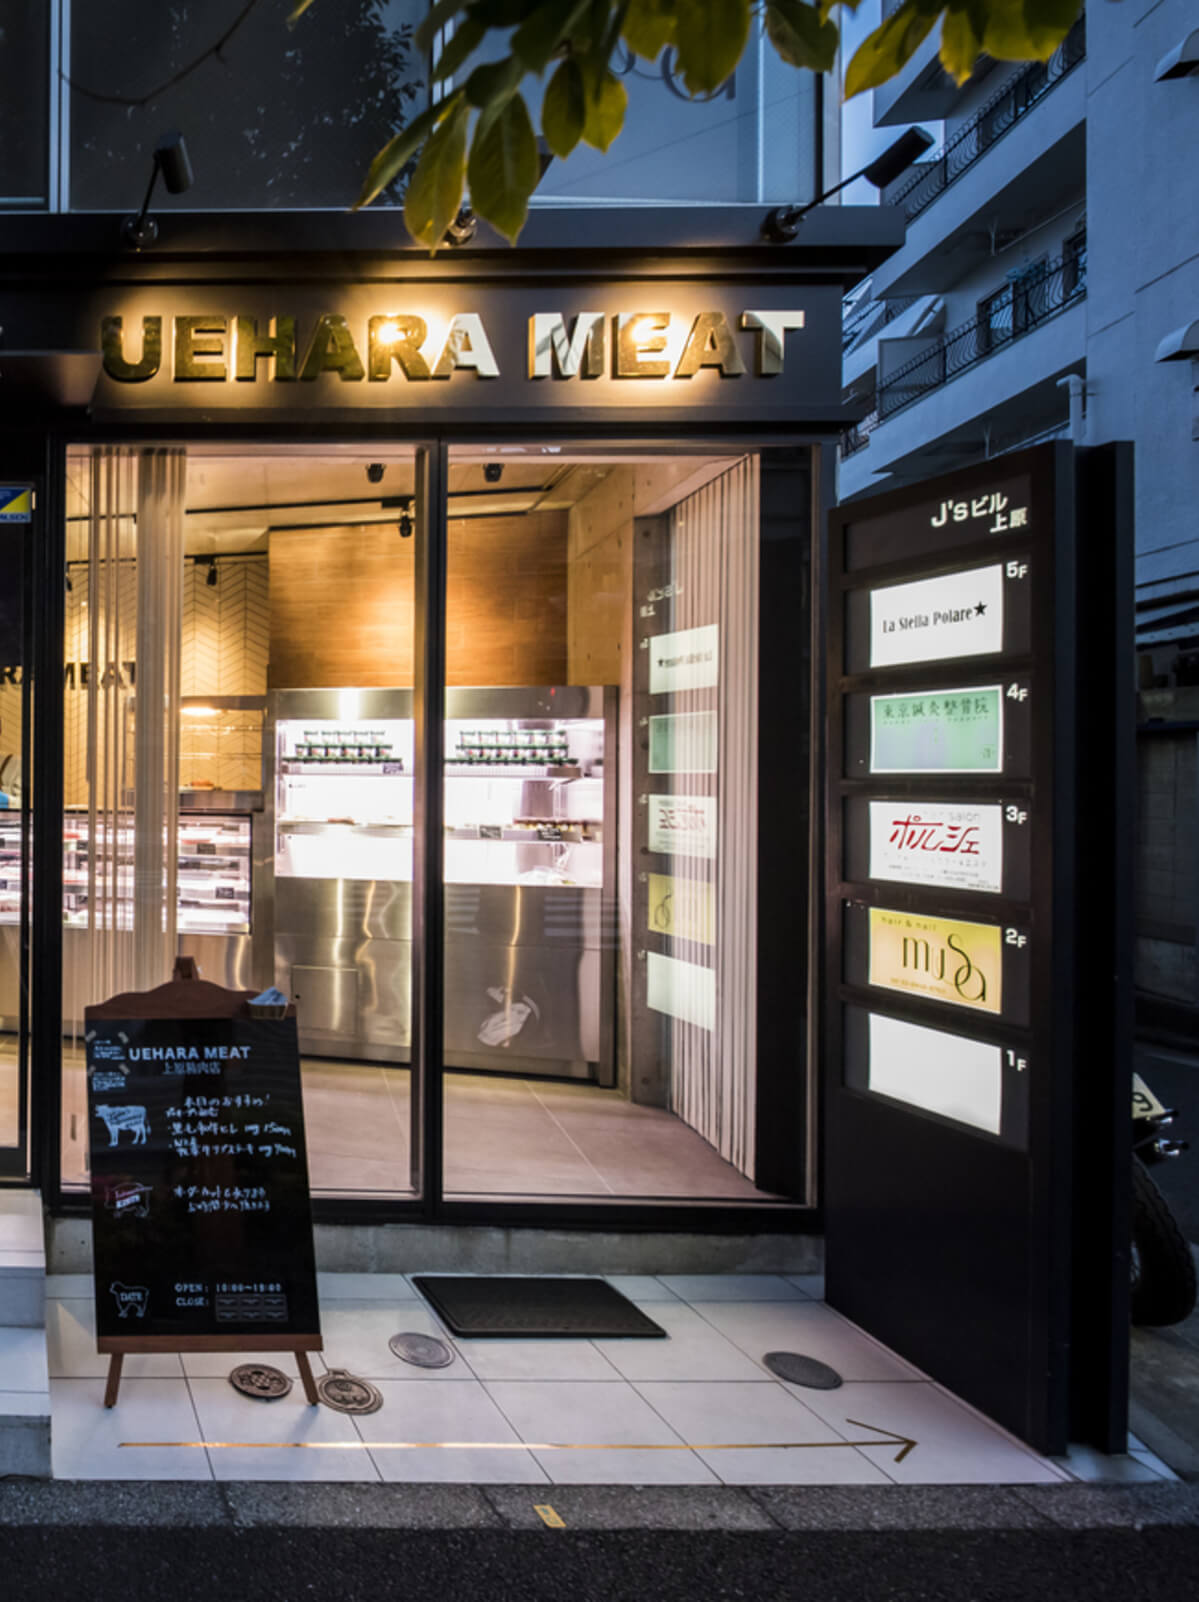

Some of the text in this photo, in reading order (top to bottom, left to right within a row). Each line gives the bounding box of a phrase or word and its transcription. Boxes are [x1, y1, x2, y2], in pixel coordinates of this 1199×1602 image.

[103, 310, 805, 382] UEHARA MEAT
[931, 492, 1008, 527] J'sビル
[990, 507, 1027, 533] 上原
[1006, 561, 1028, 579] 5F
[883, 608, 972, 633] La Stella Polare
[1006, 683, 1028, 701] 4F
[1006, 806, 1027, 824] 3F
[889, 814, 981, 855] ポルシェ
[1005, 928, 1028, 948] 2F
[129, 1047, 200, 1061] UEHARA
[204, 1045, 251, 1059] MEAT
[1006, 1050, 1027, 1071] 1F
